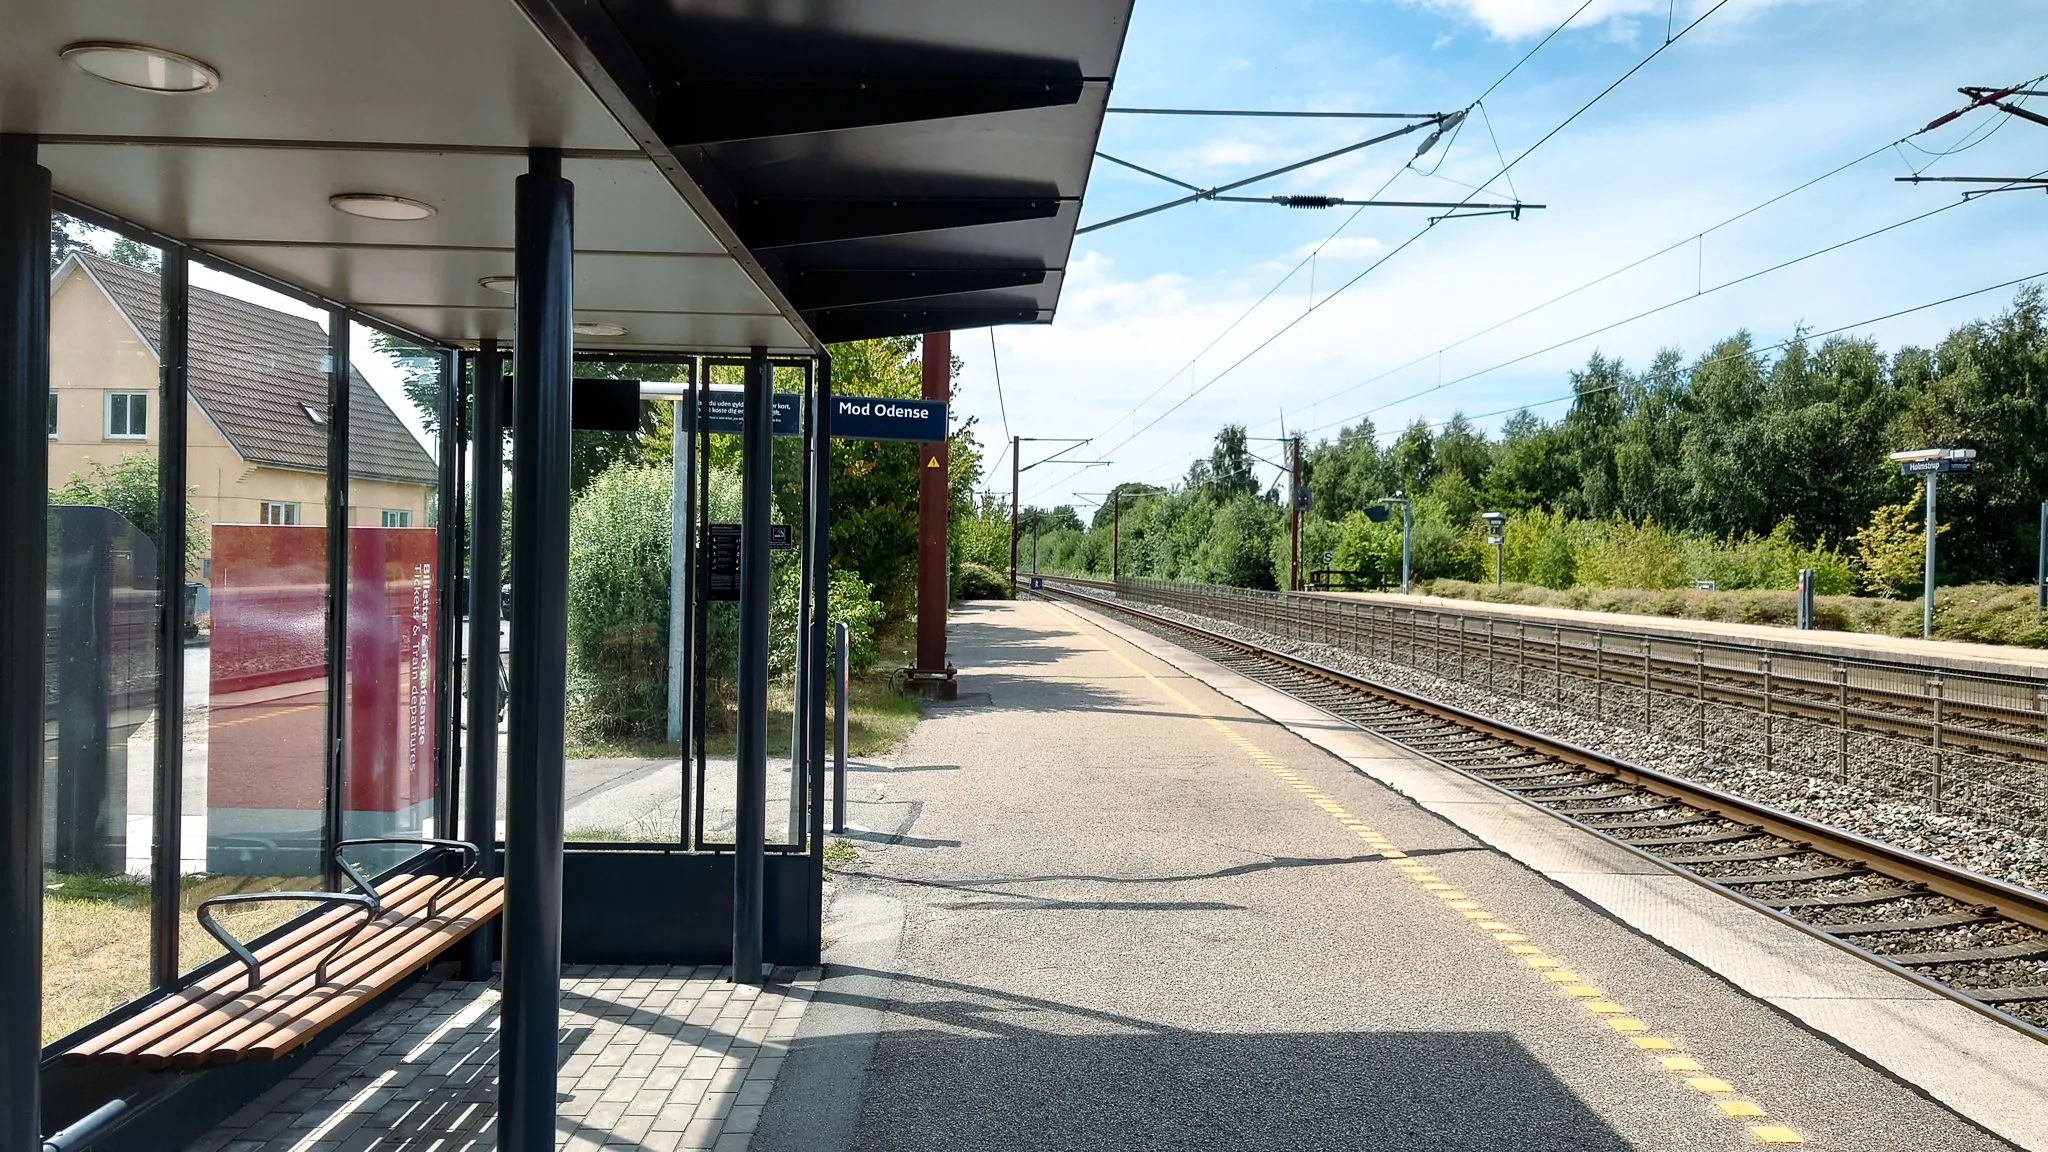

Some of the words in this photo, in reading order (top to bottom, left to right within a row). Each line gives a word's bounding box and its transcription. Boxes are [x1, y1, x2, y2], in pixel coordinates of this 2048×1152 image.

[777, 402, 791, 410] kort,
[839, 401, 870, 416] Mod
[874, 404, 929, 419] Odense
[1909, 462, 1940, 471] Holmstrup
[421, 563, 431, 630] Billetter
[412, 625, 420, 636] &
[411, 642, 420, 680] Train
[409, 685, 419, 771] departures
